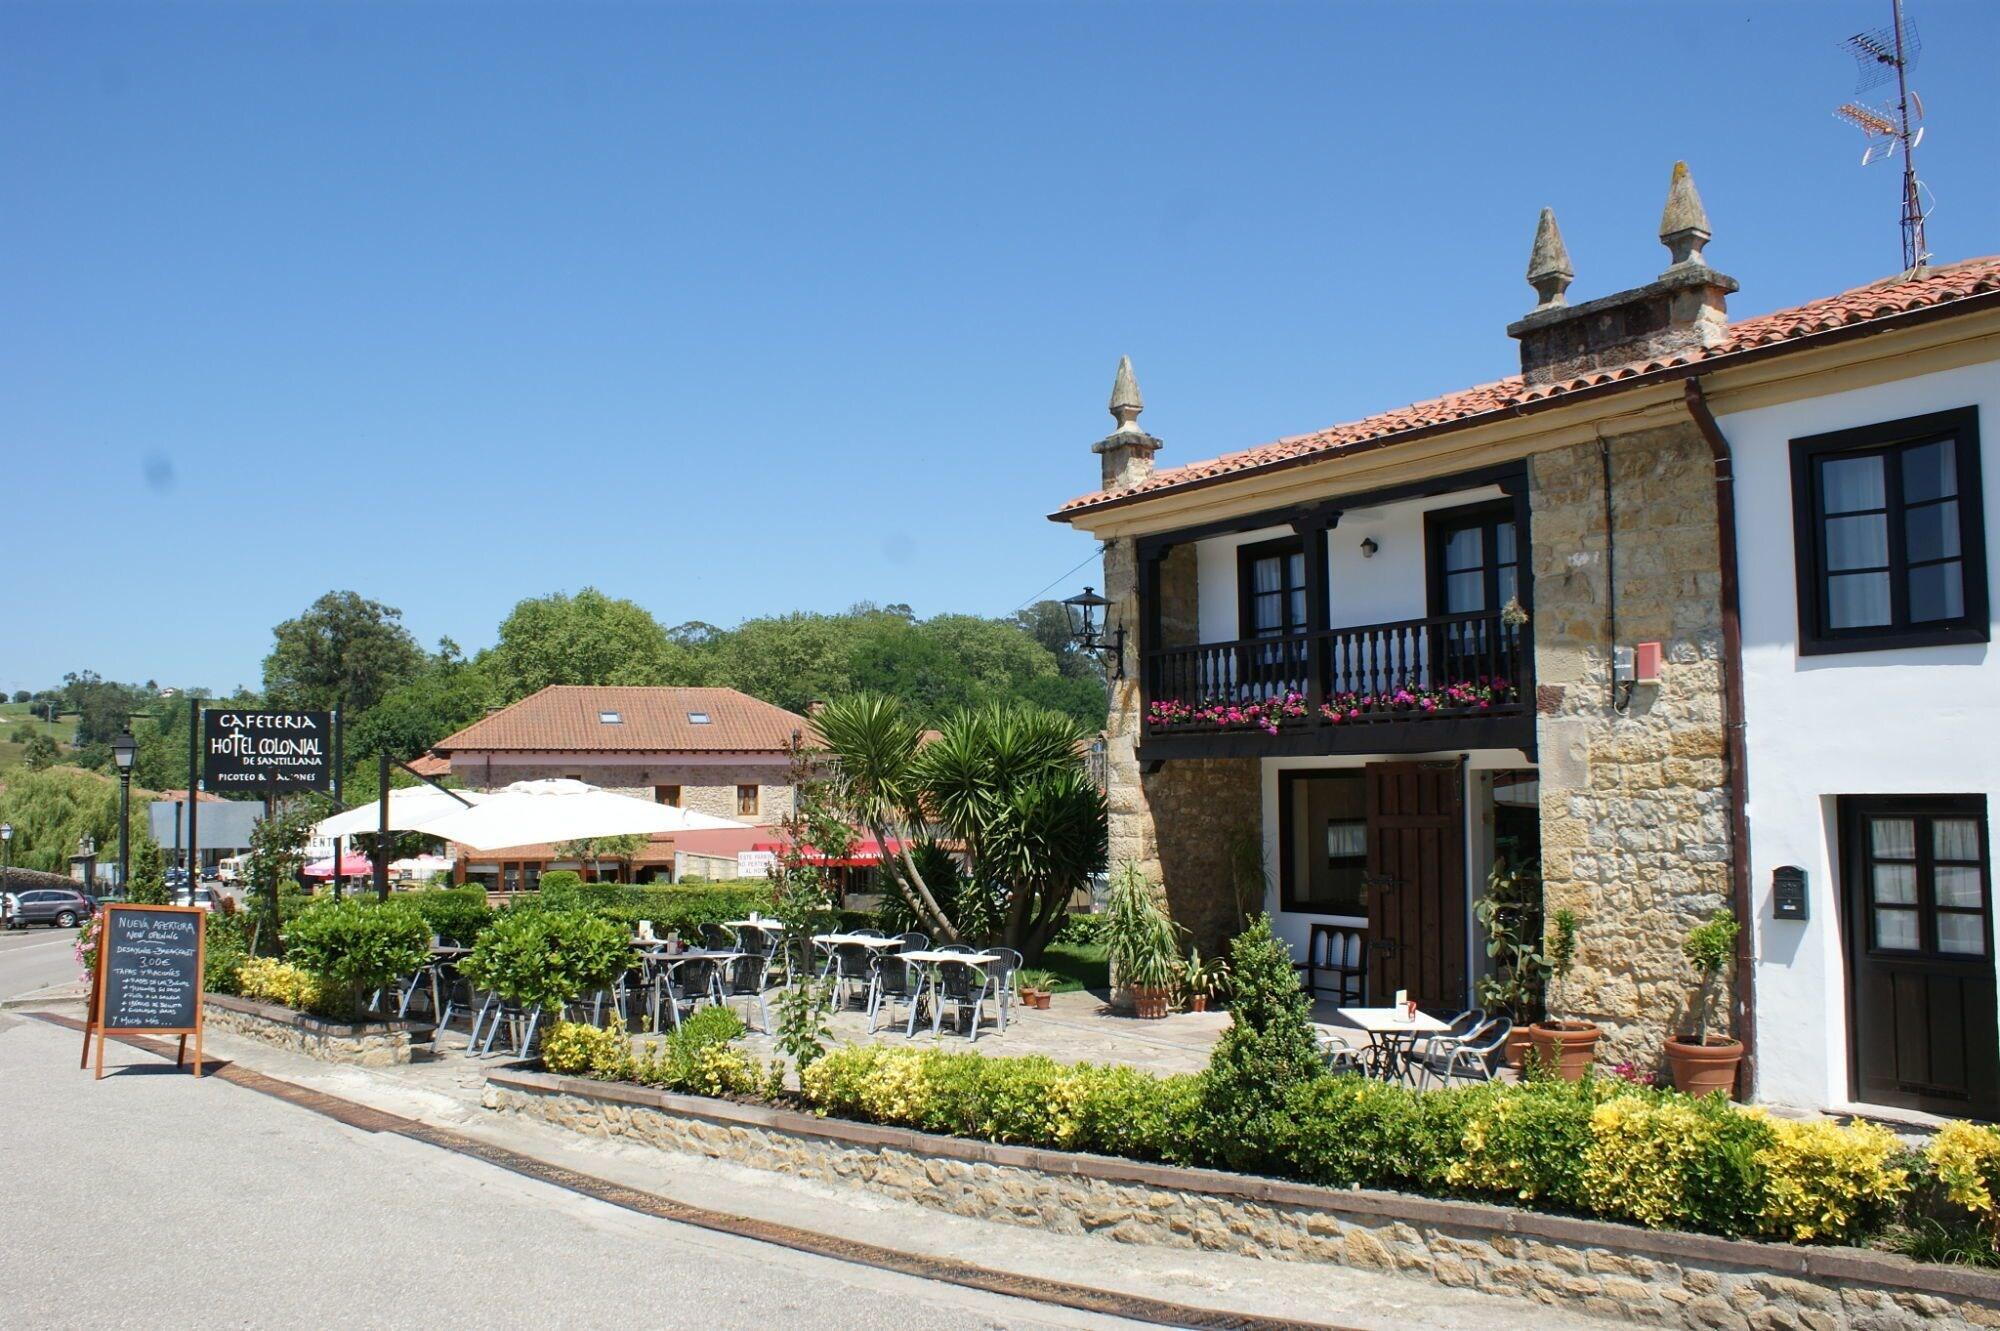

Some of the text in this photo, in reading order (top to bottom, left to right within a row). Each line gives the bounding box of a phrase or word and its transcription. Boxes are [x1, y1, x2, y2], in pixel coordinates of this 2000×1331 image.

[219, 714, 317, 729] CAFETERIA
[211, 727, 323, 757] HOTEL COLONIAL
[243, 756, 322, 766] DE SANTILLANA
[218, 773, 256, 781] PICOTEO
[258, 773, 267, 781] &
[119, 917, 195, 935] NUEVA APERTURA
[126, 930, 178, 940] NEW OPENING
[112, 968, 137, 976] TAPAS
